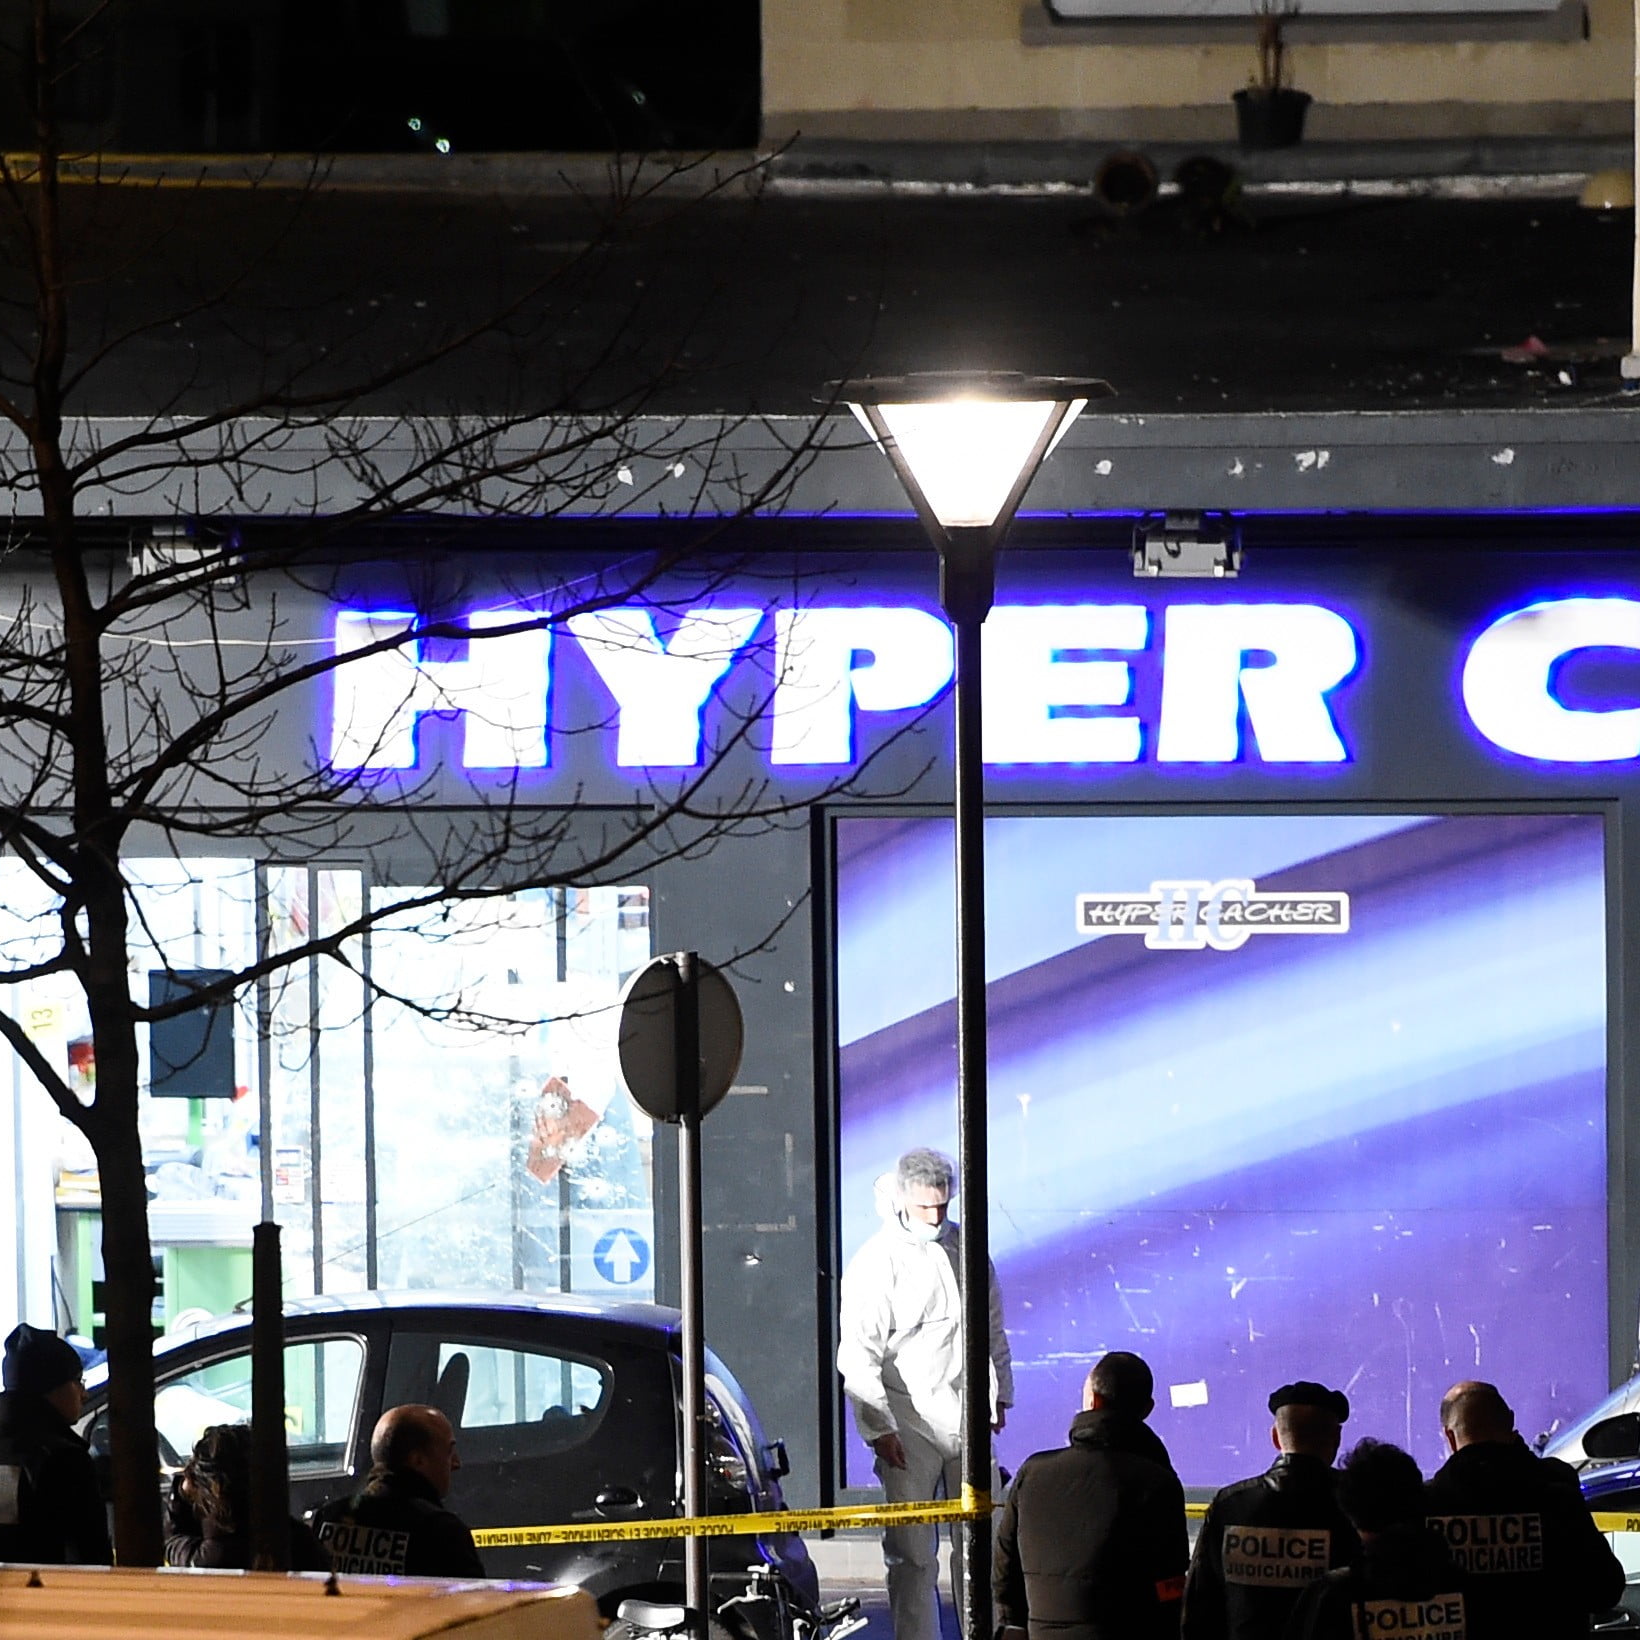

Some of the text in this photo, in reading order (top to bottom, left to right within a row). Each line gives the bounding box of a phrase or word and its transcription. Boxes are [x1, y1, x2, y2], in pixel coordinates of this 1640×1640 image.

[332, 603, 1361, 771] HYPER
[1087, 902, 1336, 927] HYPER CACHER
[322, 1524, 407, 1562] POLICE
[1226, 1534, 1326, 1559] POLICE
[1226, 1563, 1325, 1579] JUDICIAIRE
